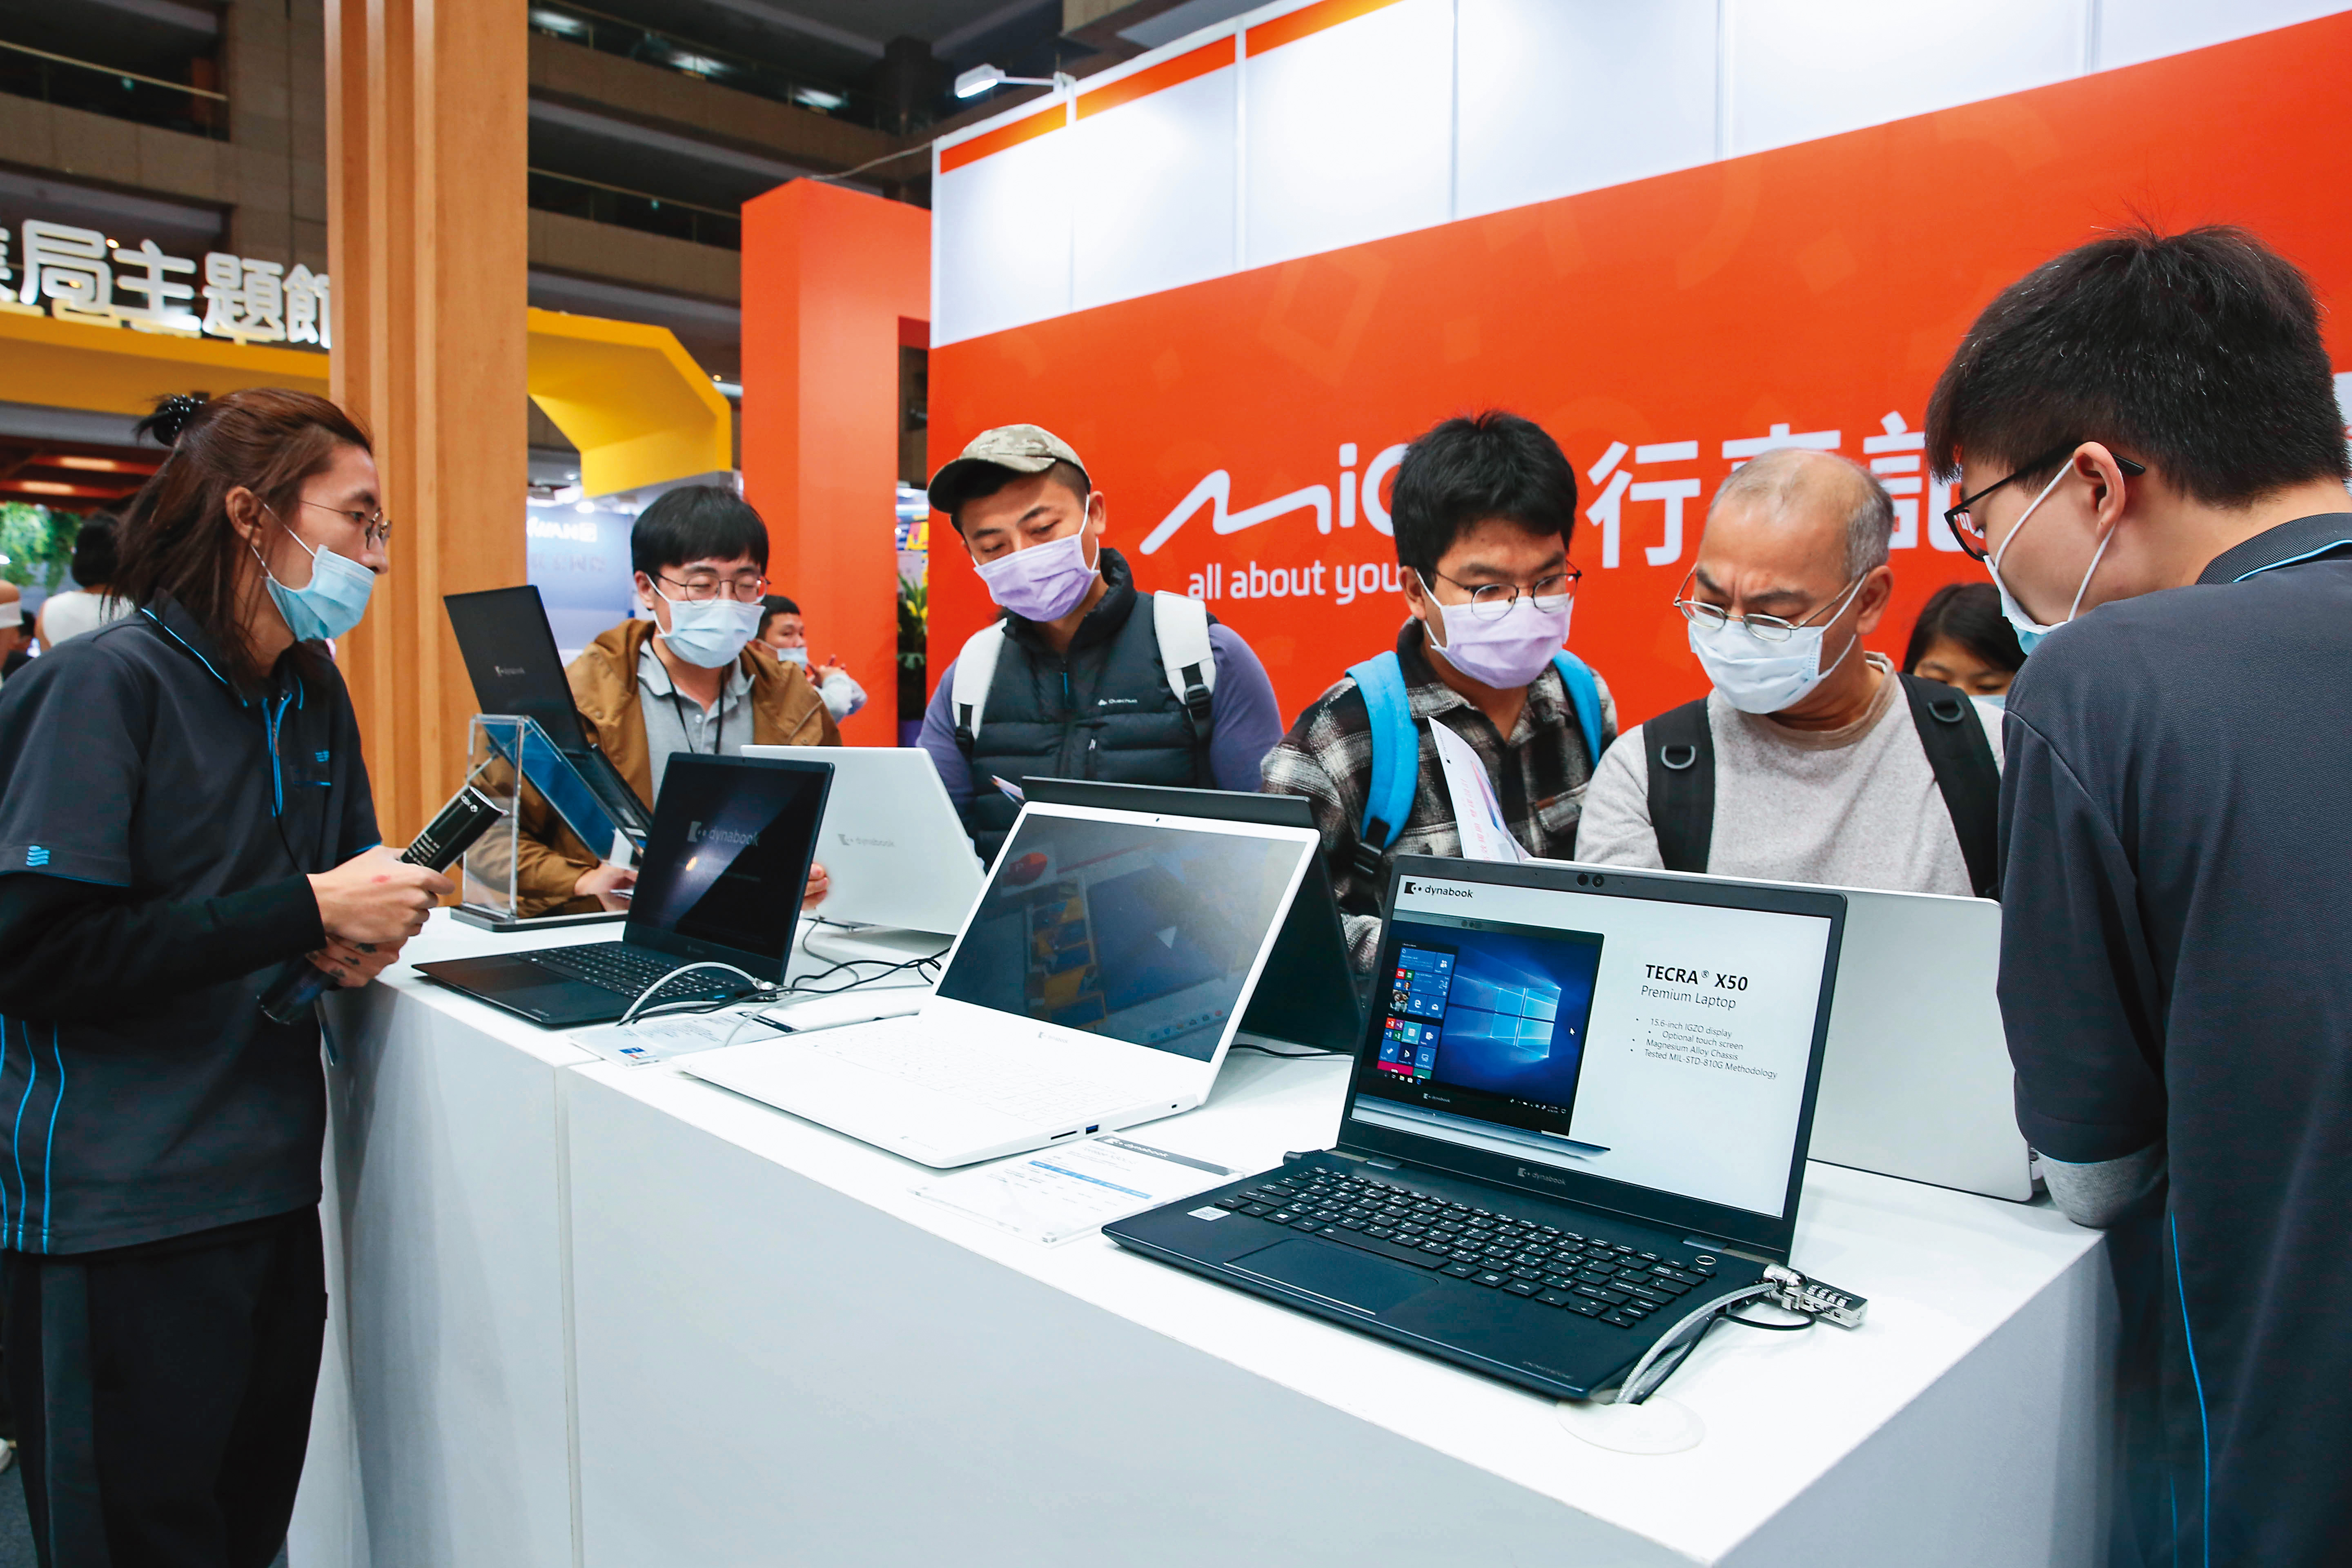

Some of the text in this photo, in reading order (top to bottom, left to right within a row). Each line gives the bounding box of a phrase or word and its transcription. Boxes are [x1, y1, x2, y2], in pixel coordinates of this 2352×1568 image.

[0, 219, 332, 349] 局主題館
[1188, 560, 1402, 605] all about you
[709, 826, 758, 846] dynabook
[1425, 885, 1473, 898] dynabook
[1714, 973, 1748, 991] X50
[1641, 985, 1736, 1011] Premium Laptop
[1650, 1018, 1732, 1039] 15.6-inch IGZO display
[1646, 1038, 1738, 1060] Magnesium Alloy Chassis
[1662, 1030, 1744, 1051] Optional touch screen
[1644, 1049, 1777, 1080] Tested MIL-STD-810G Methodology
[1532, 1172, 1566, 1185] dynabook
